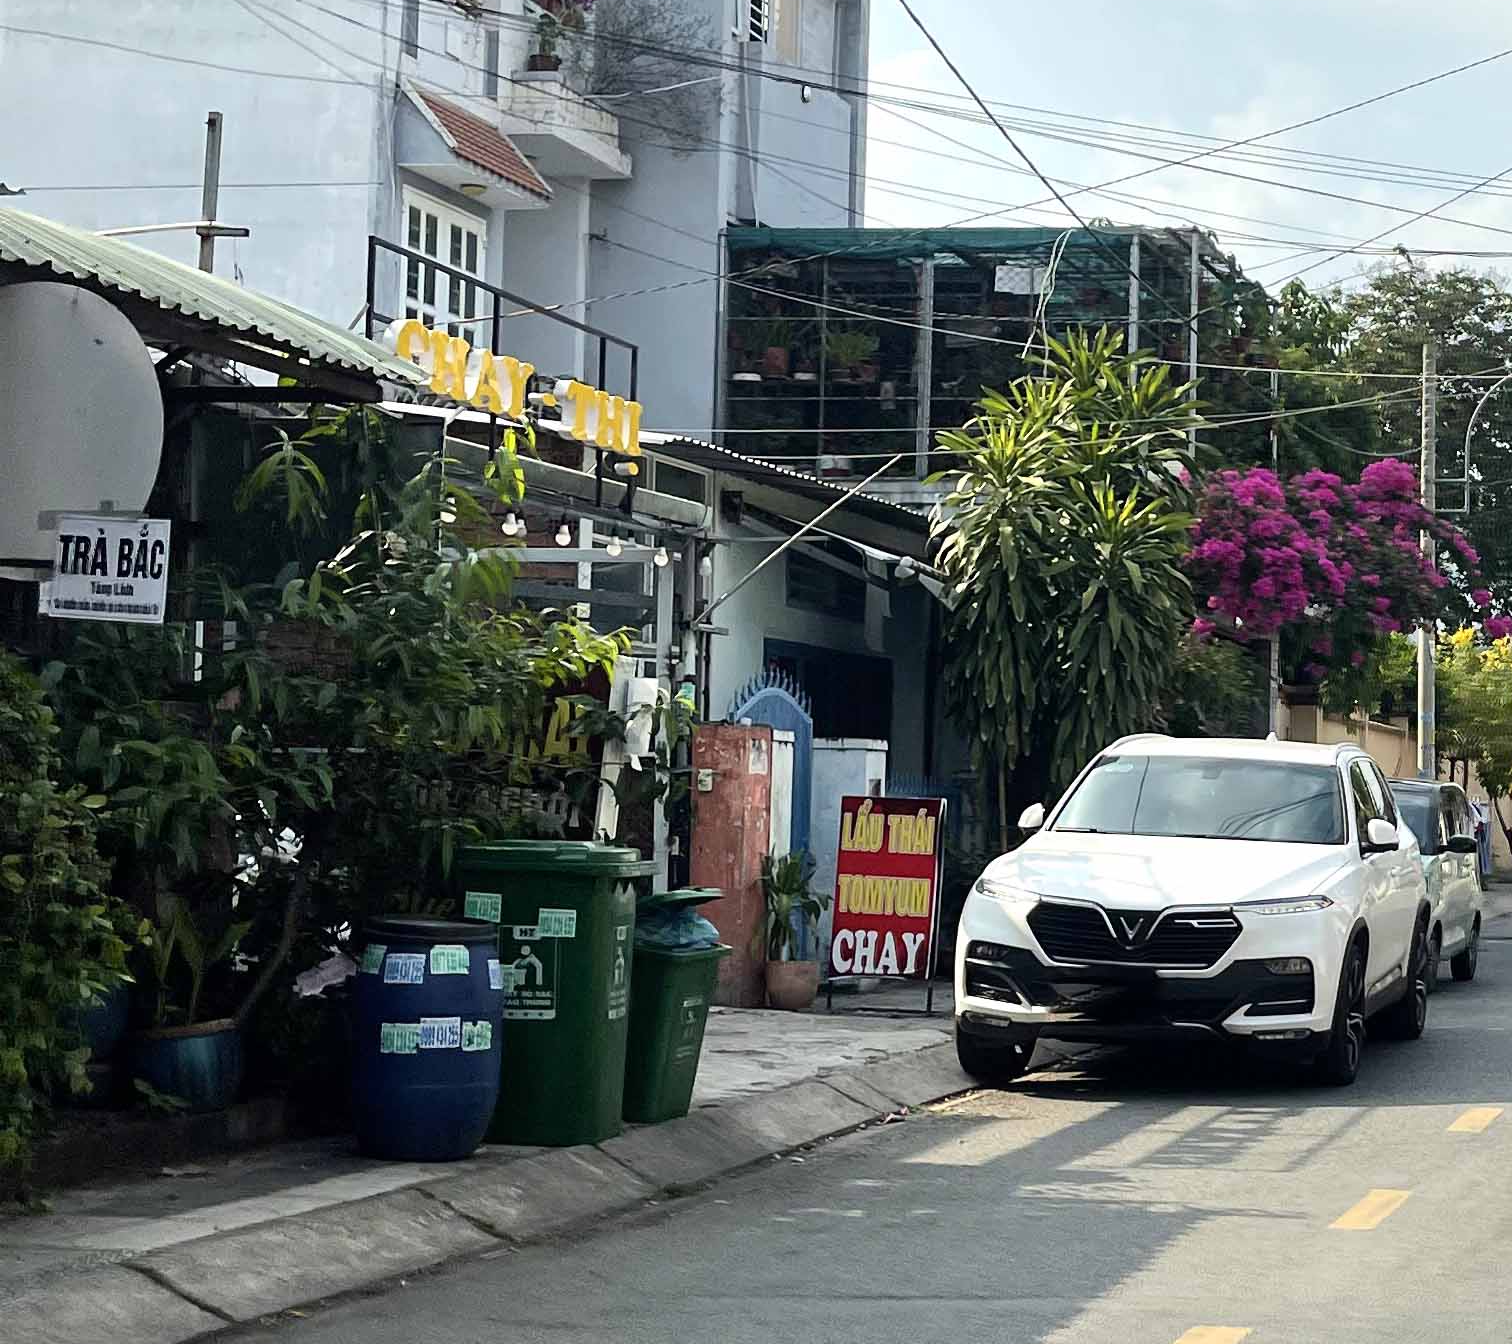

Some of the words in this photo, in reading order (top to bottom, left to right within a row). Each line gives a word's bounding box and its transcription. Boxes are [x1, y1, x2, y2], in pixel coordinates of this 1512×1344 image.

[388, 319, 534, 419] CHAY
[60, 527, 108, 576] TRÀ
[117, 523, 165, 580] BẮC
[841, 799, 885, 853] LẨU
[887, 808, 935, 855] THÁI
[838, 873, 931, 917] TOMYUM
[832, 928, 925, 975] CHAY
